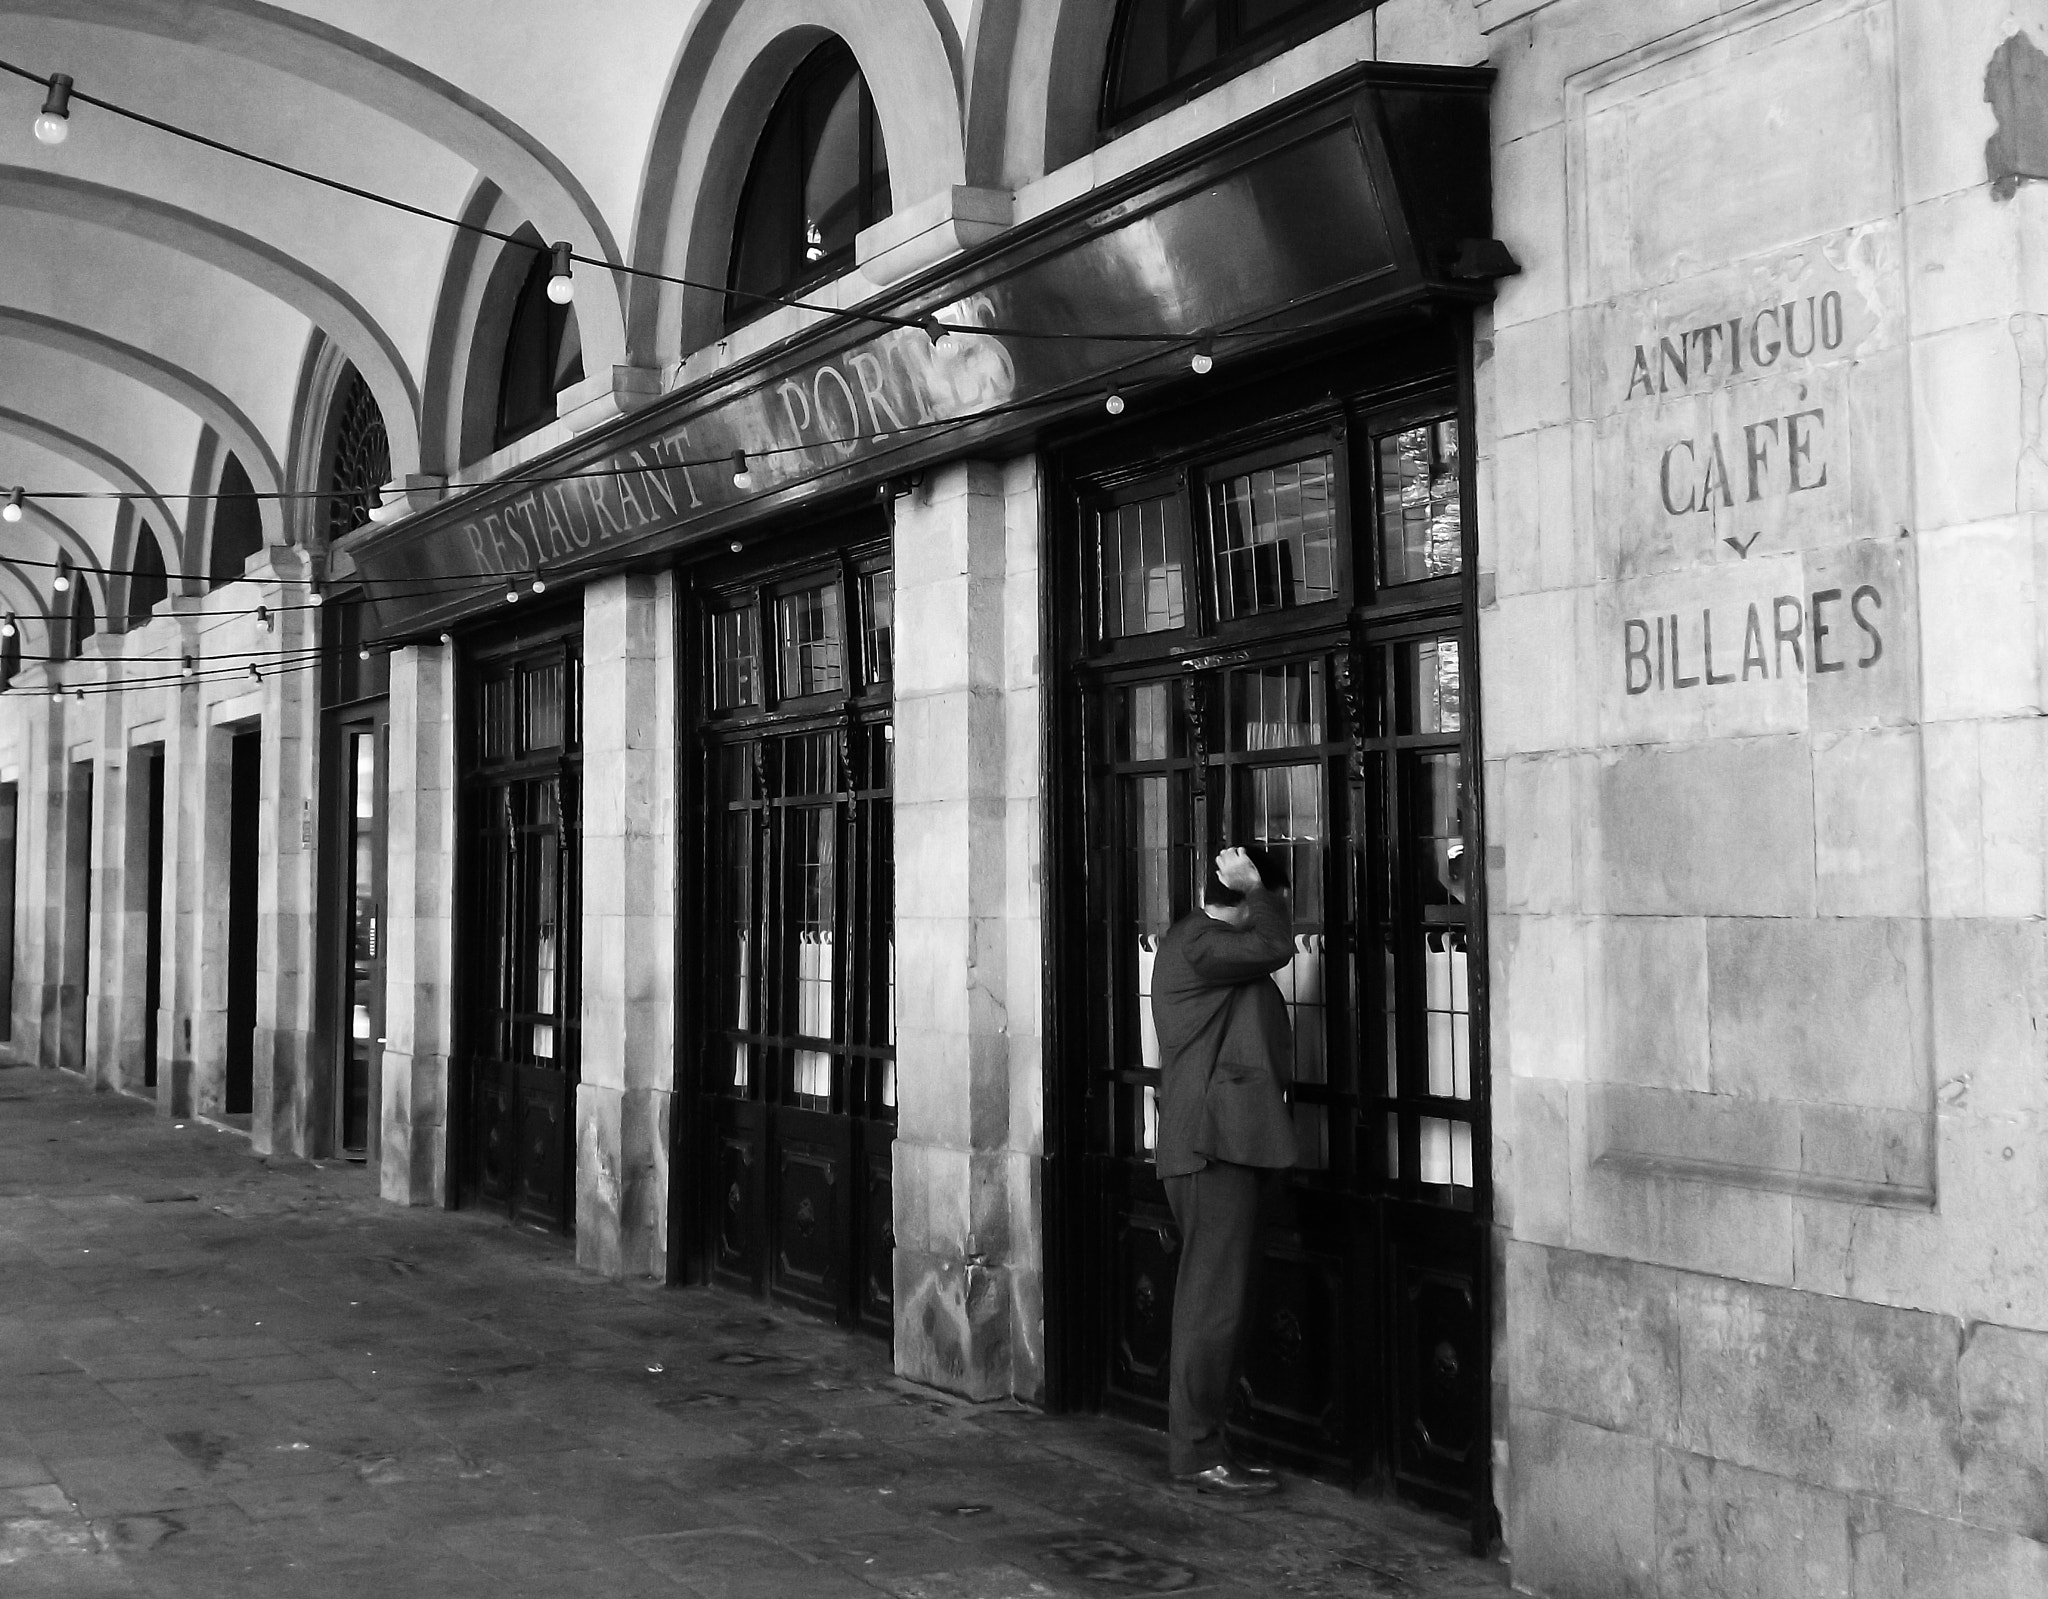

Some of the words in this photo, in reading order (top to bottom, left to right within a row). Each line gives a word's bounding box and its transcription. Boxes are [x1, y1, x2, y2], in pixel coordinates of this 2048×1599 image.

[1624, 290, 1844, 401] ANTIGUO
[463, 427, 702, 583] RESTAURANT
[1660, 384, 1828, 516] CAFÉ
[1723, 531, 1761, 560] Y
[1624, 584, 1883, 696] BILLARES
